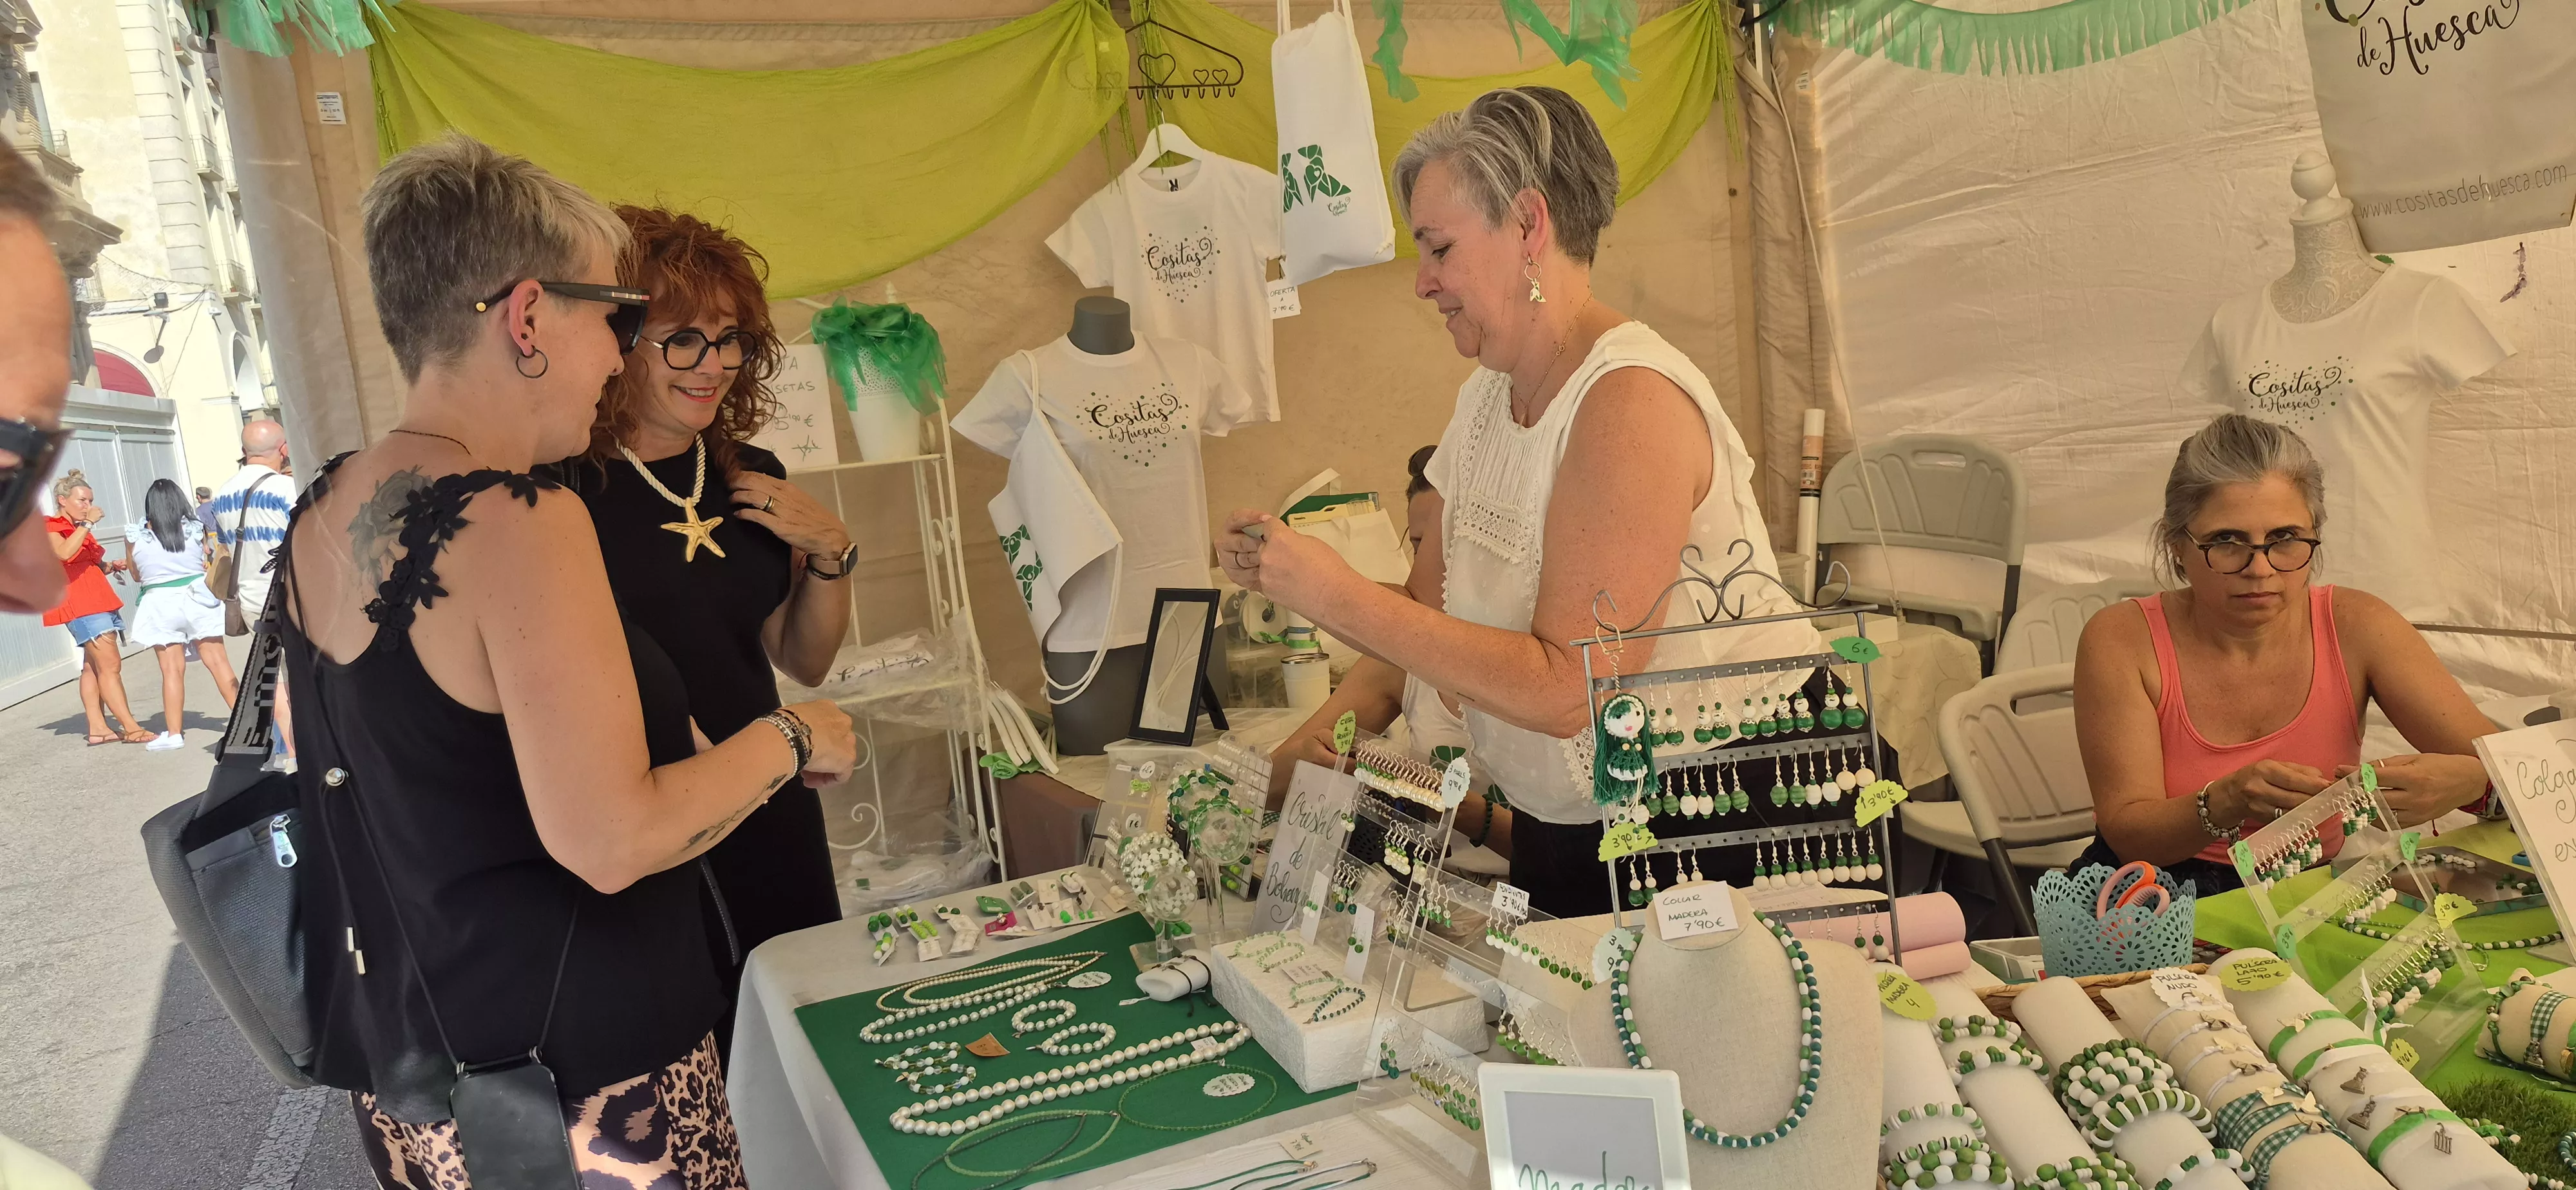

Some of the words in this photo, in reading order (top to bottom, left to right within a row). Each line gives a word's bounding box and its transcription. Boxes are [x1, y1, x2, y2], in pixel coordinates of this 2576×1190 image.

[2378, 0, 2519, 75] Huesca
[2360, 164, 2567, 219] www.cositasdehuesca.com
[1146, 237, 1212, 270] Cositas
[1162, 268, 1200, 284] Huesca
[1270, 286, 1296, 297] OFERTA
[2248, 366, 2342, 397] Cositas
[1084, 393, 1179, 428] Cositas
[2267, 395, 2320, 415] Huesca
[1117, 422, 1171, 444] Huesca
[1289, 836, 1303, 870] de
[1663, 894, 1702, 905] COLLAR
[1668, 908, 1709, 921] MADERA
